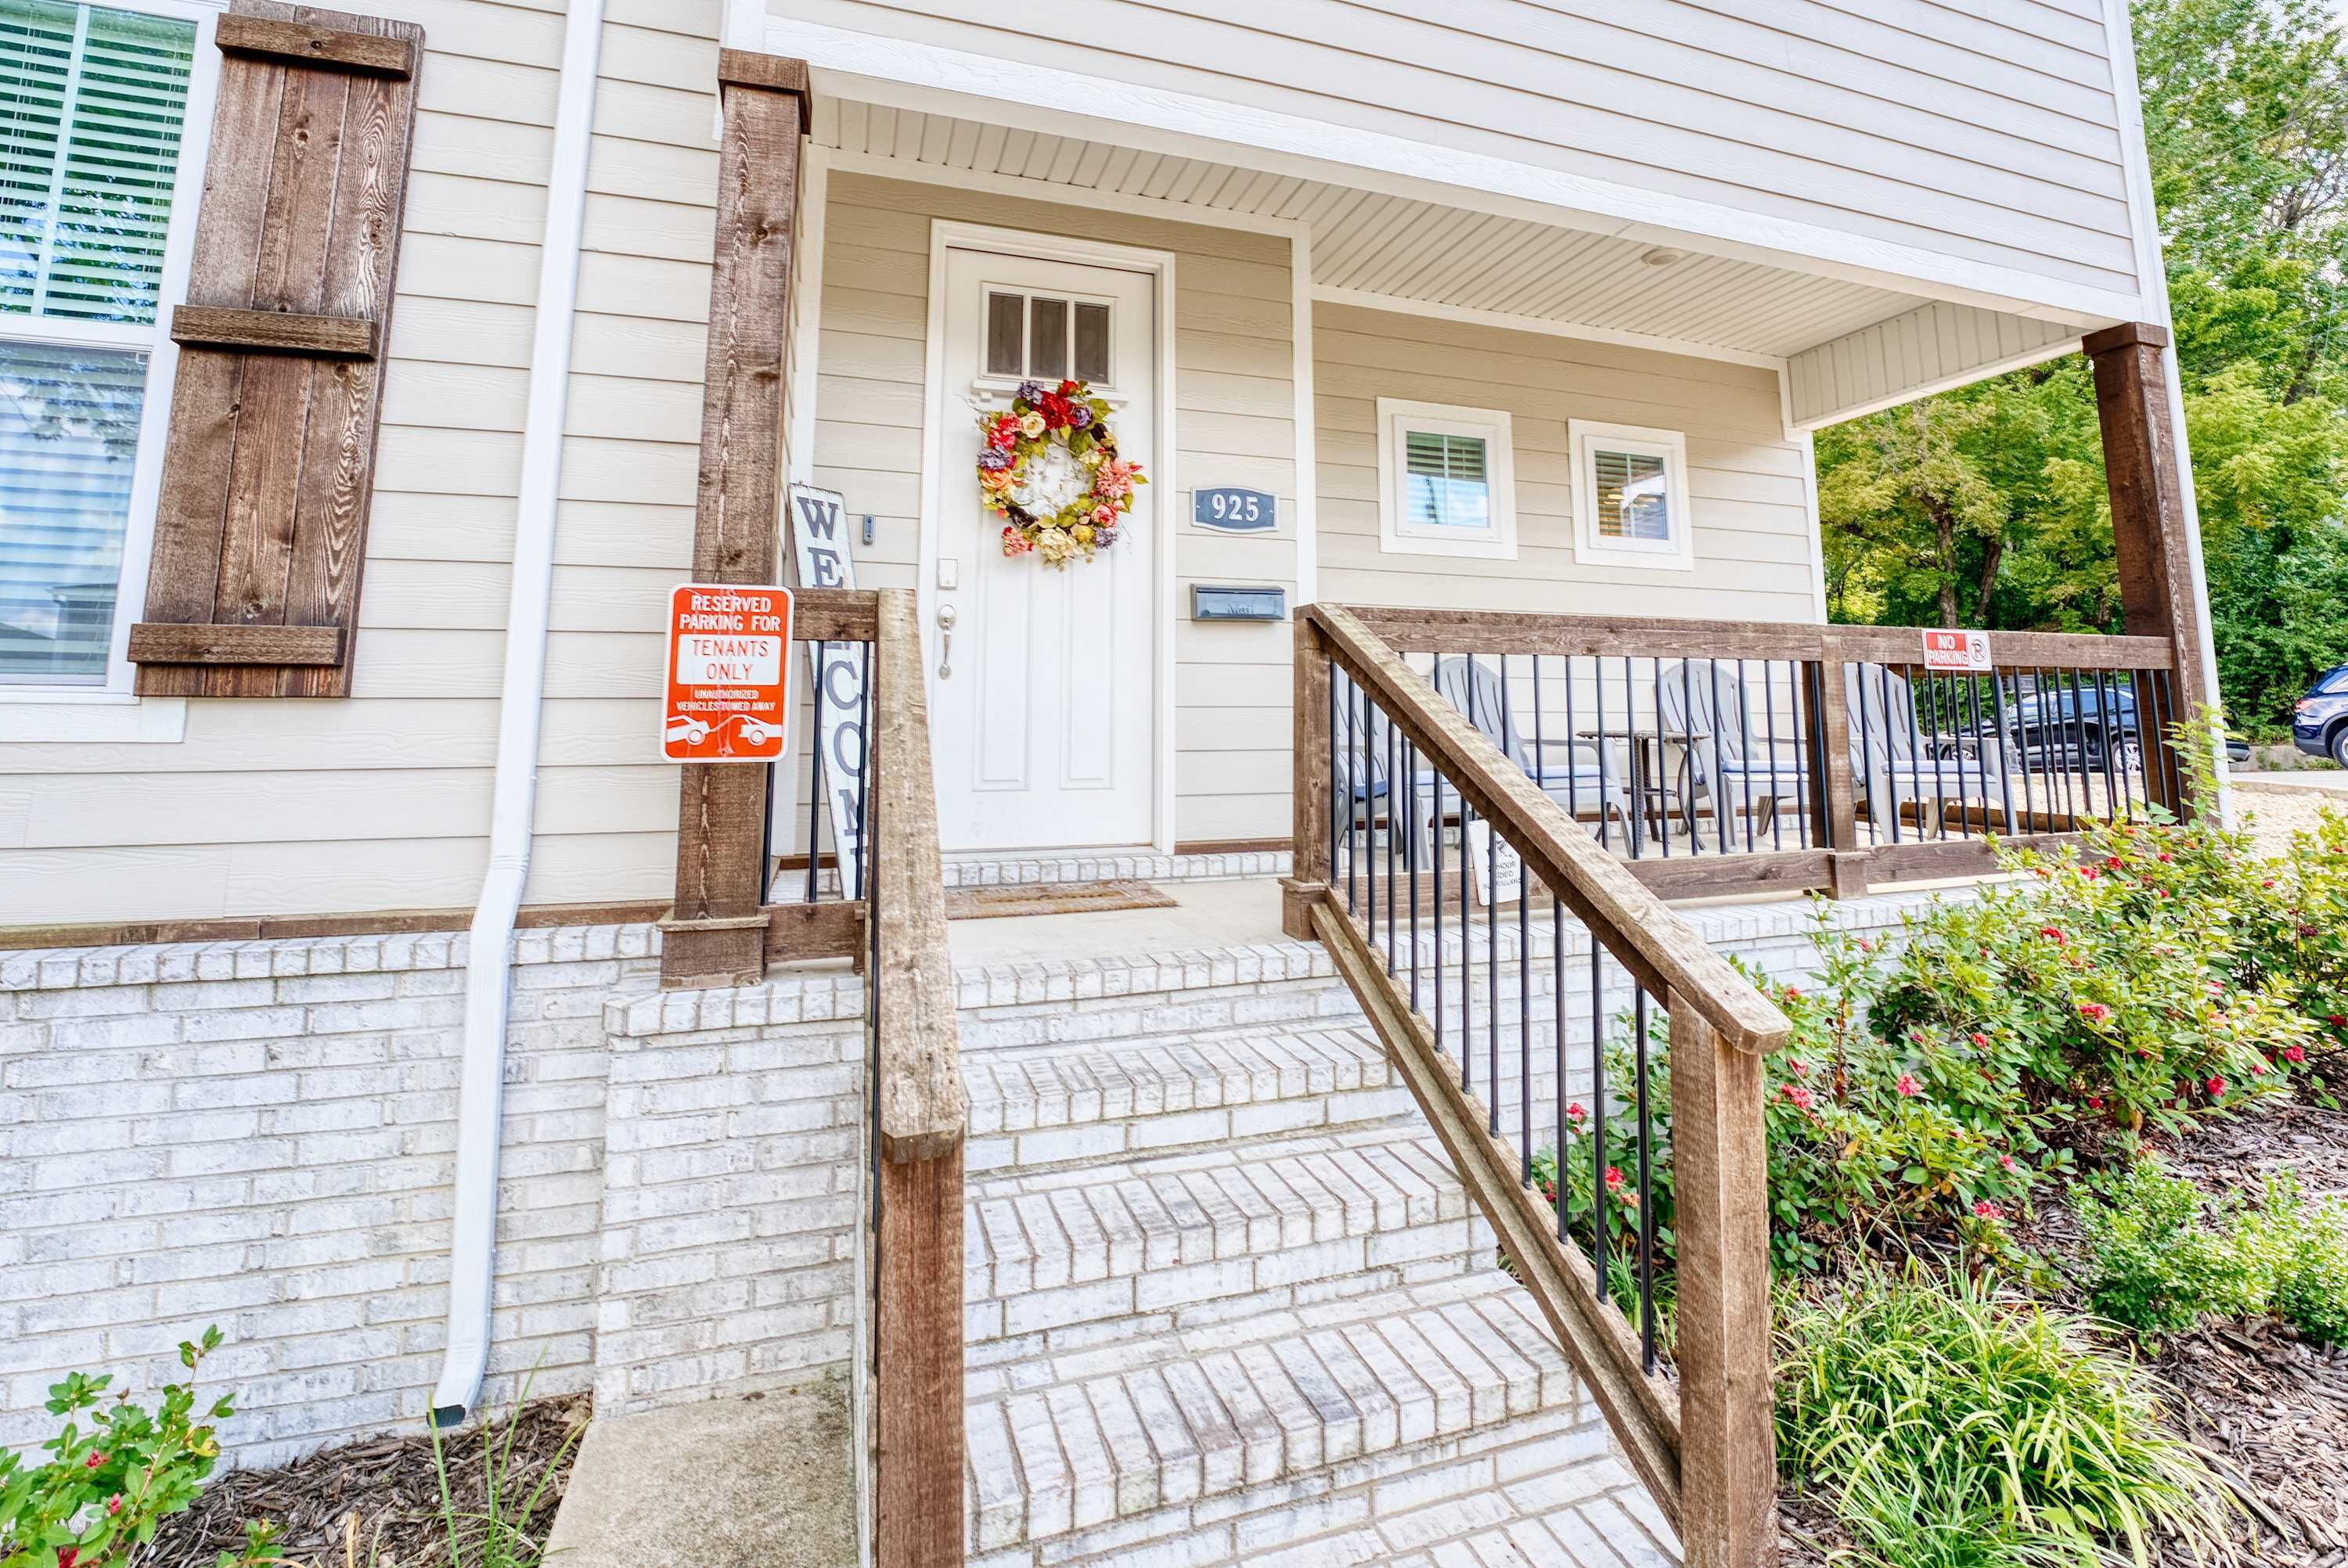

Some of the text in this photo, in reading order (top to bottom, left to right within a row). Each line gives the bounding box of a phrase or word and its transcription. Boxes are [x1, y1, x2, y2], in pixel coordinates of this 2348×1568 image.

[1211, 493, 1260, 522] 925
[690, 595, 772, 613] RESERVED
[679, 613, 781, 631] PARKING FOR
[693, 638, 769, 657] TENANTS
[1936, 634, 1956, 649] NO
[1927, 649, 1969, 664] PARKING
[706, 663, 753, 681] ONLY
[694, 689, 760, 699] UNAUTHORIZED
[675, 700, 776, 711] VEHICLES TOWED AWAY
